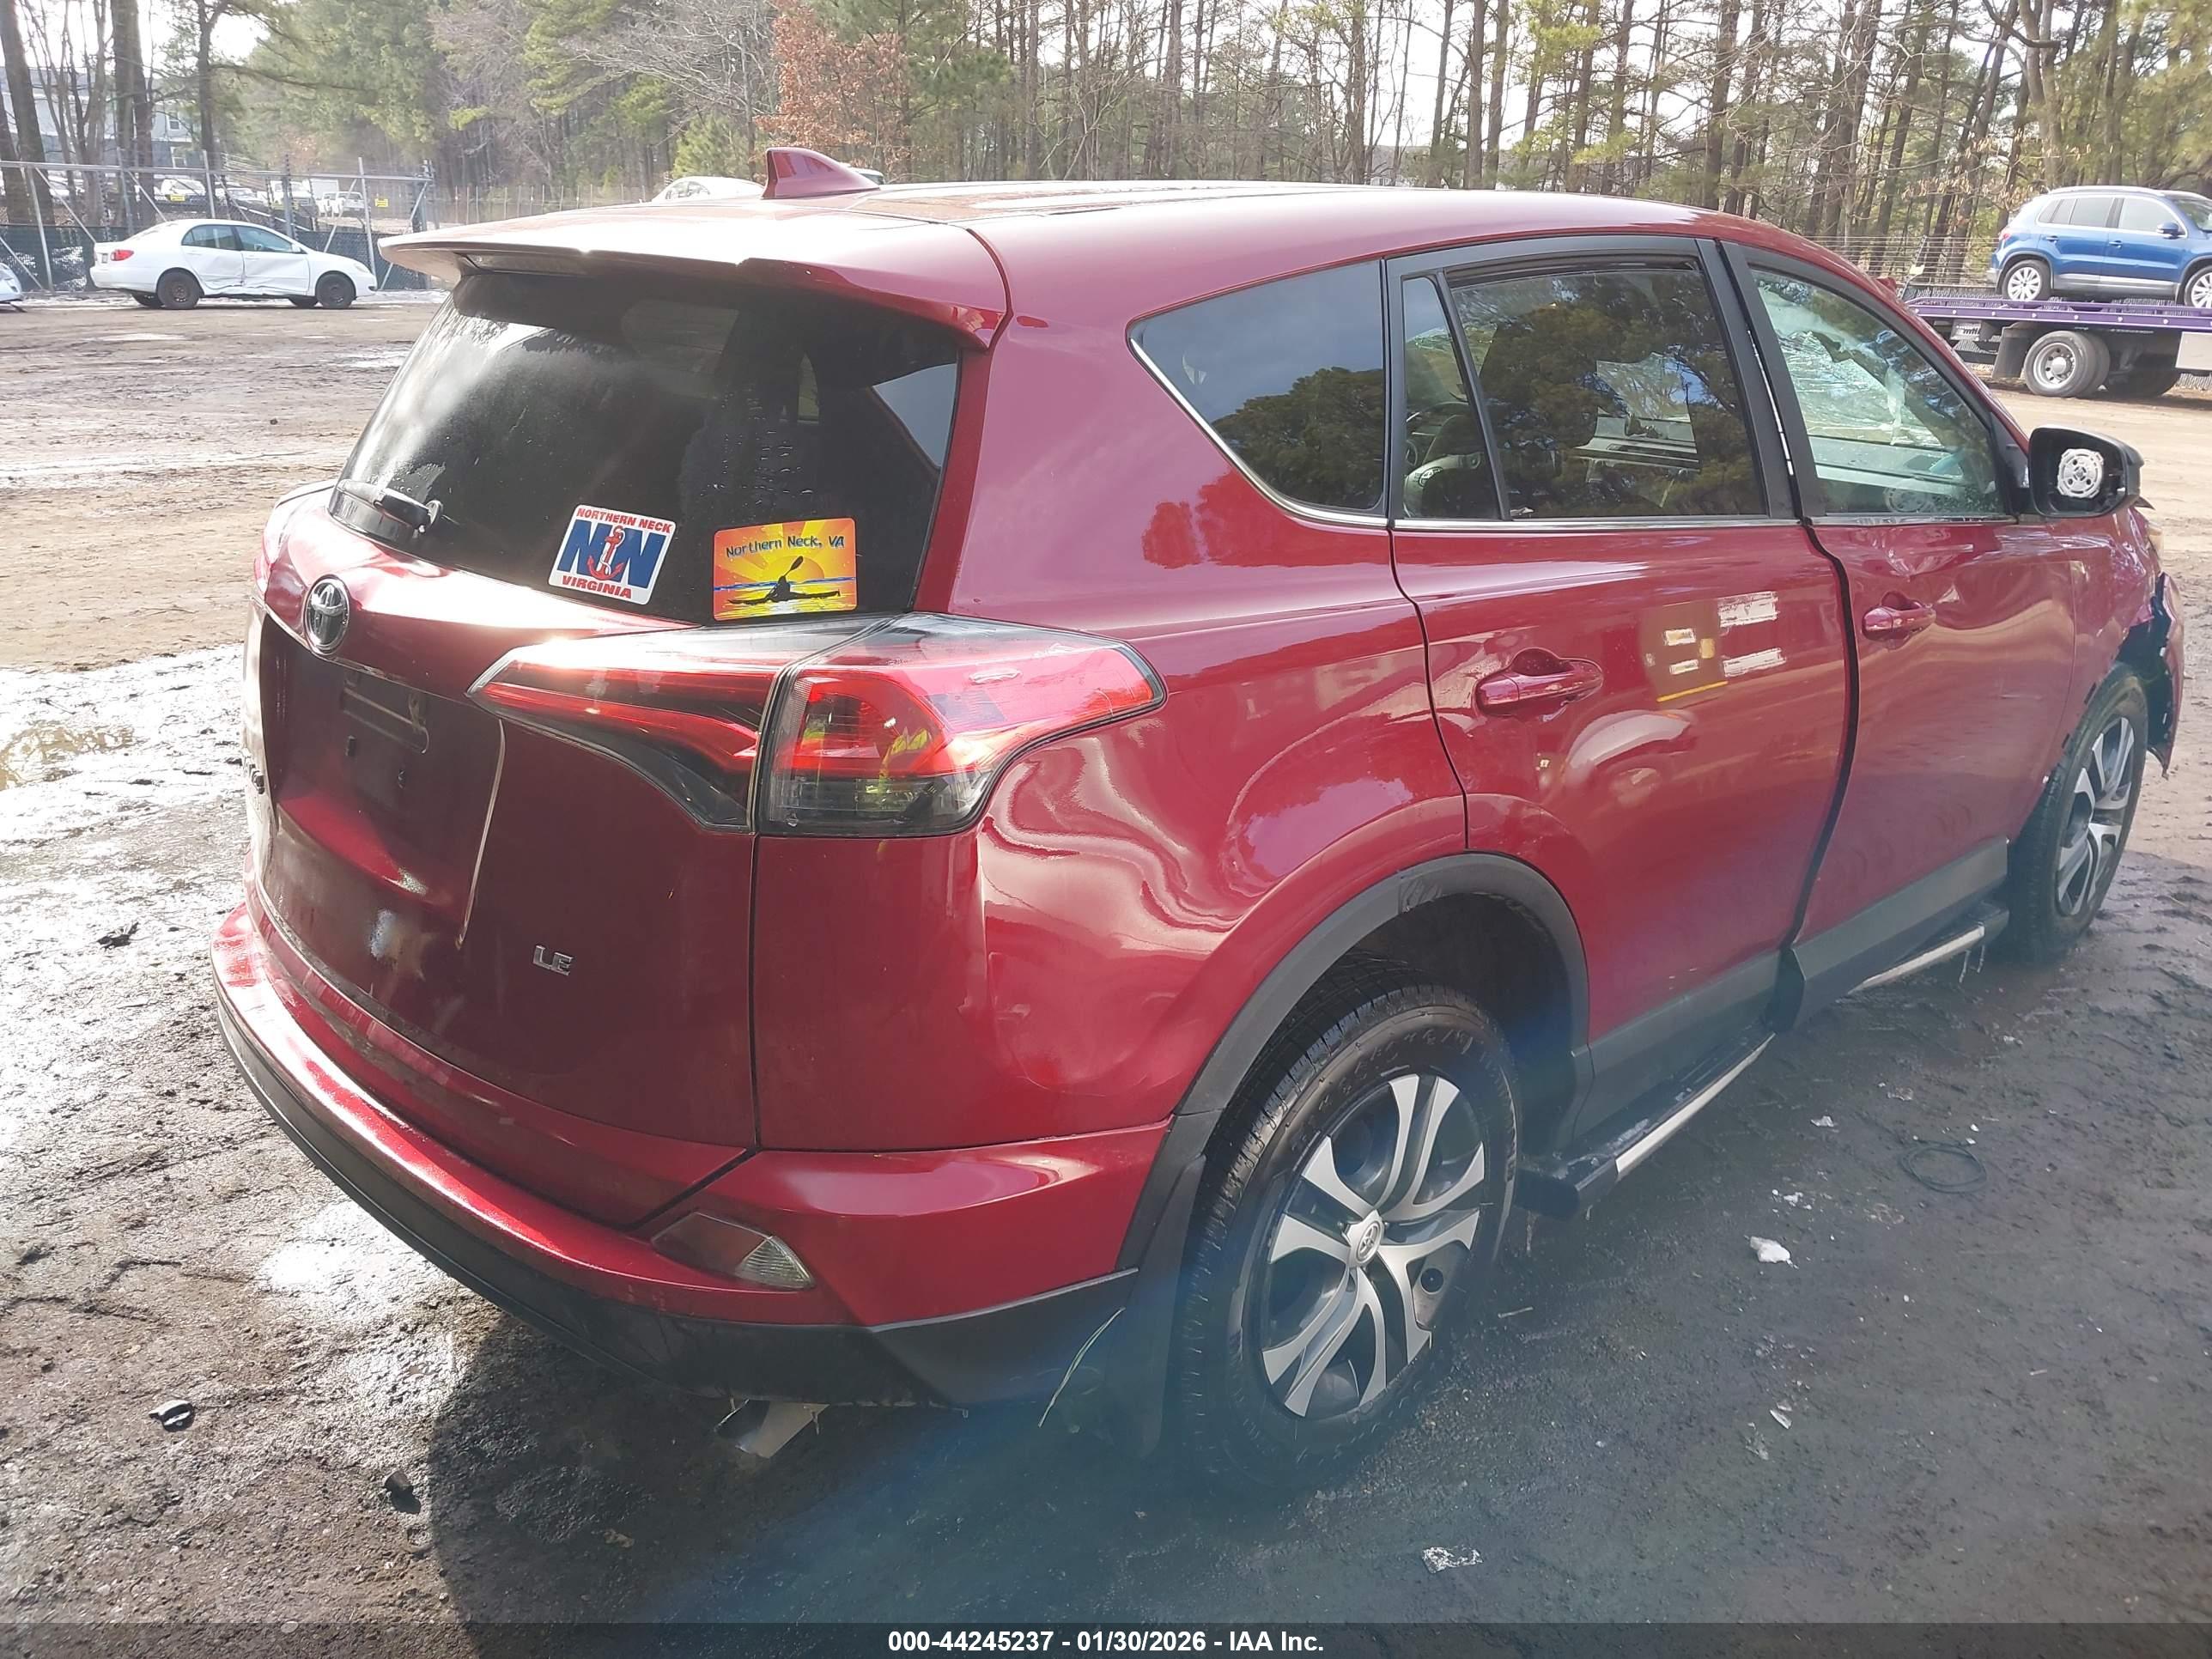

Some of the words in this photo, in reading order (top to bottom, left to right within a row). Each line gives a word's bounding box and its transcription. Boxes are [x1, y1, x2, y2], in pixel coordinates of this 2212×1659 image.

[576, 507, 637, 526] NORTHERN
[638, 518, 672, 533] NECK
[726, 538, 782, 557] Northern
[787, 535, 823, 548] Neck,
[829, 535, 845, 549] VA
[562, 574, 633, 599] VIRGINIA
[532, 945, 574, 976] LE
